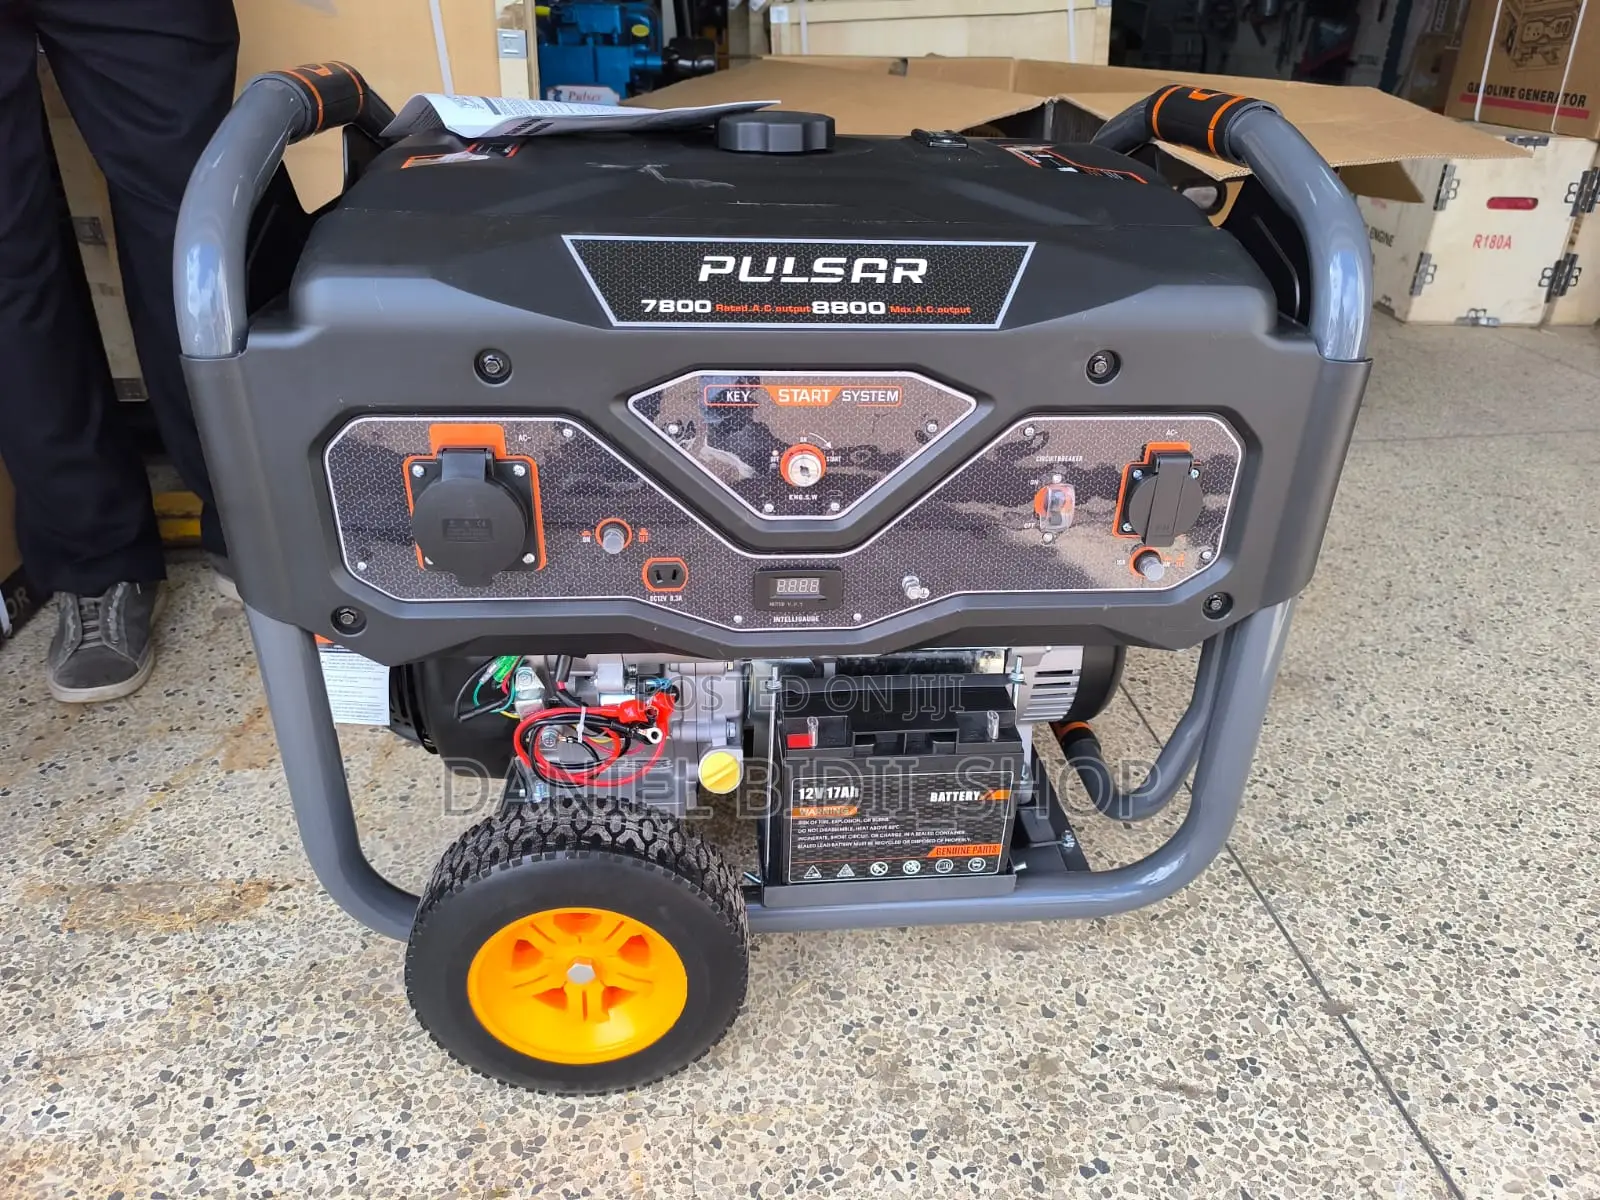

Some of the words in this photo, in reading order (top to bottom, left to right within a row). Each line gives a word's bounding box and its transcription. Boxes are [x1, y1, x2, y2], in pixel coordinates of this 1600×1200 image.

[1369, 226, 1395, 248] ENGINE
[1472, 234, 1512, 249] R180A
[698, 256, 928, 284] PULSAR
[641, 300, 712, 314] 7800
[811, 301, 886, 315] 8800
[726, 390, 751, 403] KEY
[778, 389, 832, 403] START
[842, 390, 899, 403] SYSTEM
[799, 787, 825, 800] 12V
[826, 785, 860, 799] 17Ah
[930, 790, 981, 803] BATTERY
[800, 806, 849, 818] WARNING
[936, 846, 971, 856] GENUINE
[972, 845, 998, 854] PARTS
